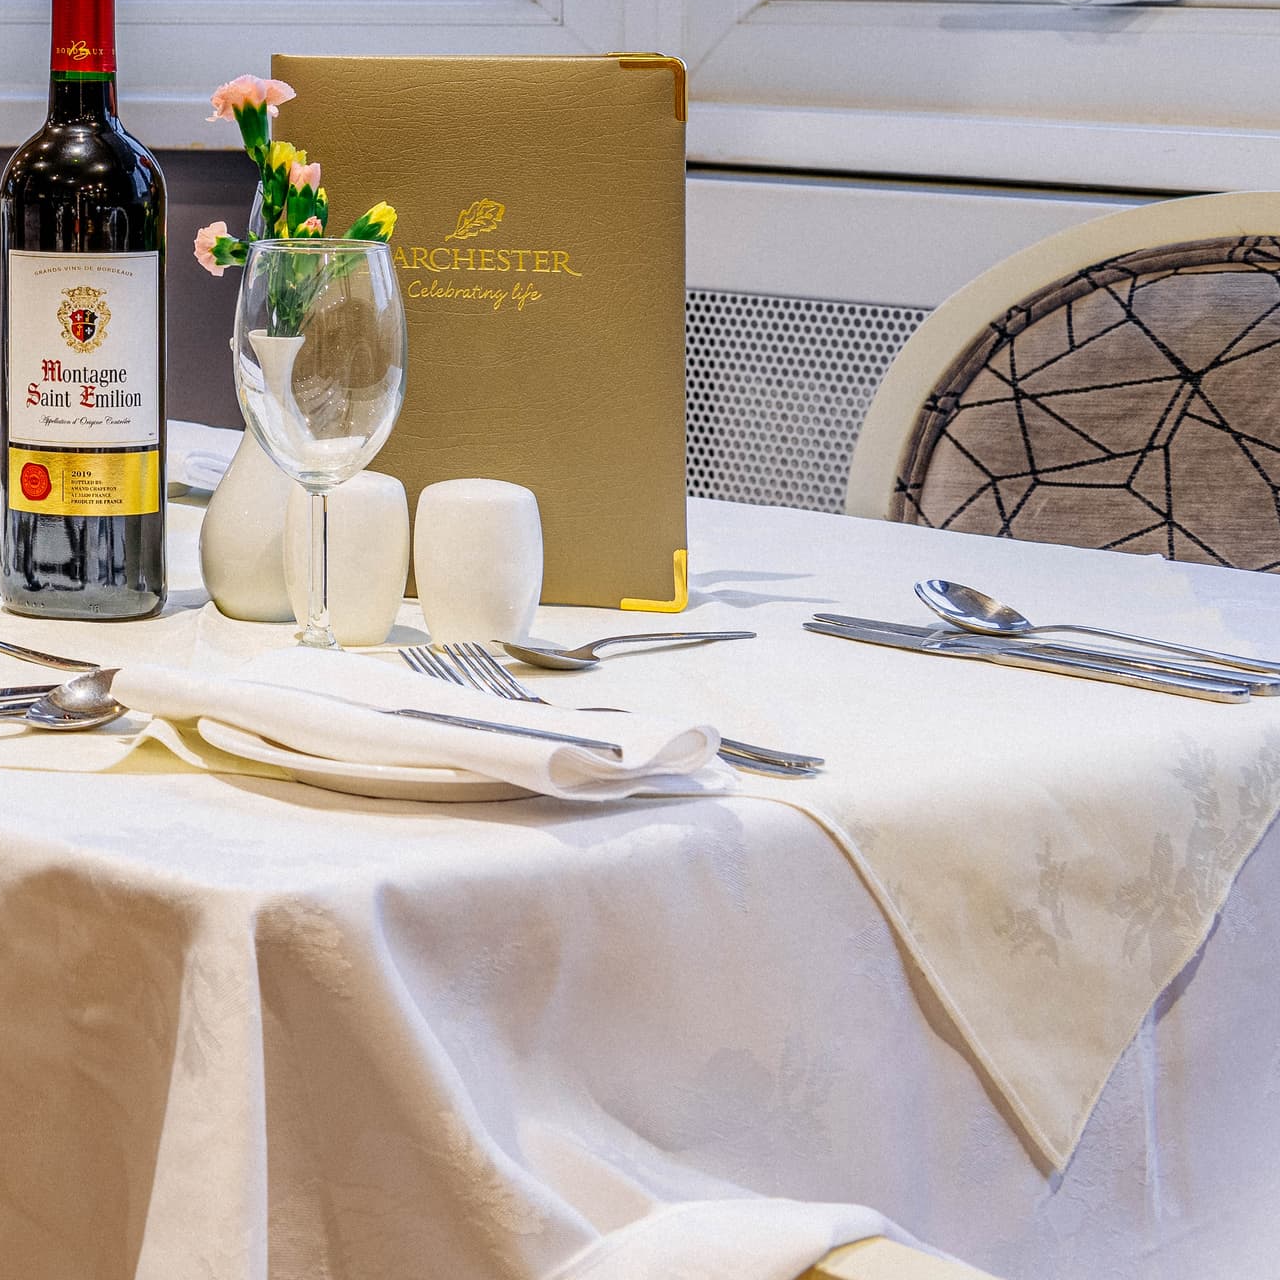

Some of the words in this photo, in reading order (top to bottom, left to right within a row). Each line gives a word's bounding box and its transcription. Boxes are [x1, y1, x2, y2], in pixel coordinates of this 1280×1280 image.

[56, 47, 104, 56] BORDEAUX
[33, 267, 62, 276] GRANDS
[96, 266, 134, 277] BORDEAUX
[391, 246, 583, 277] ARCHESTER
[407, 279, 508, 310] Celebrating
[511, 281, 542, 311] life
[41, 359, 128, 387] Montagne
[26, 383, 72, 409] Saint
[79, 384, 143, 409] Emilion
